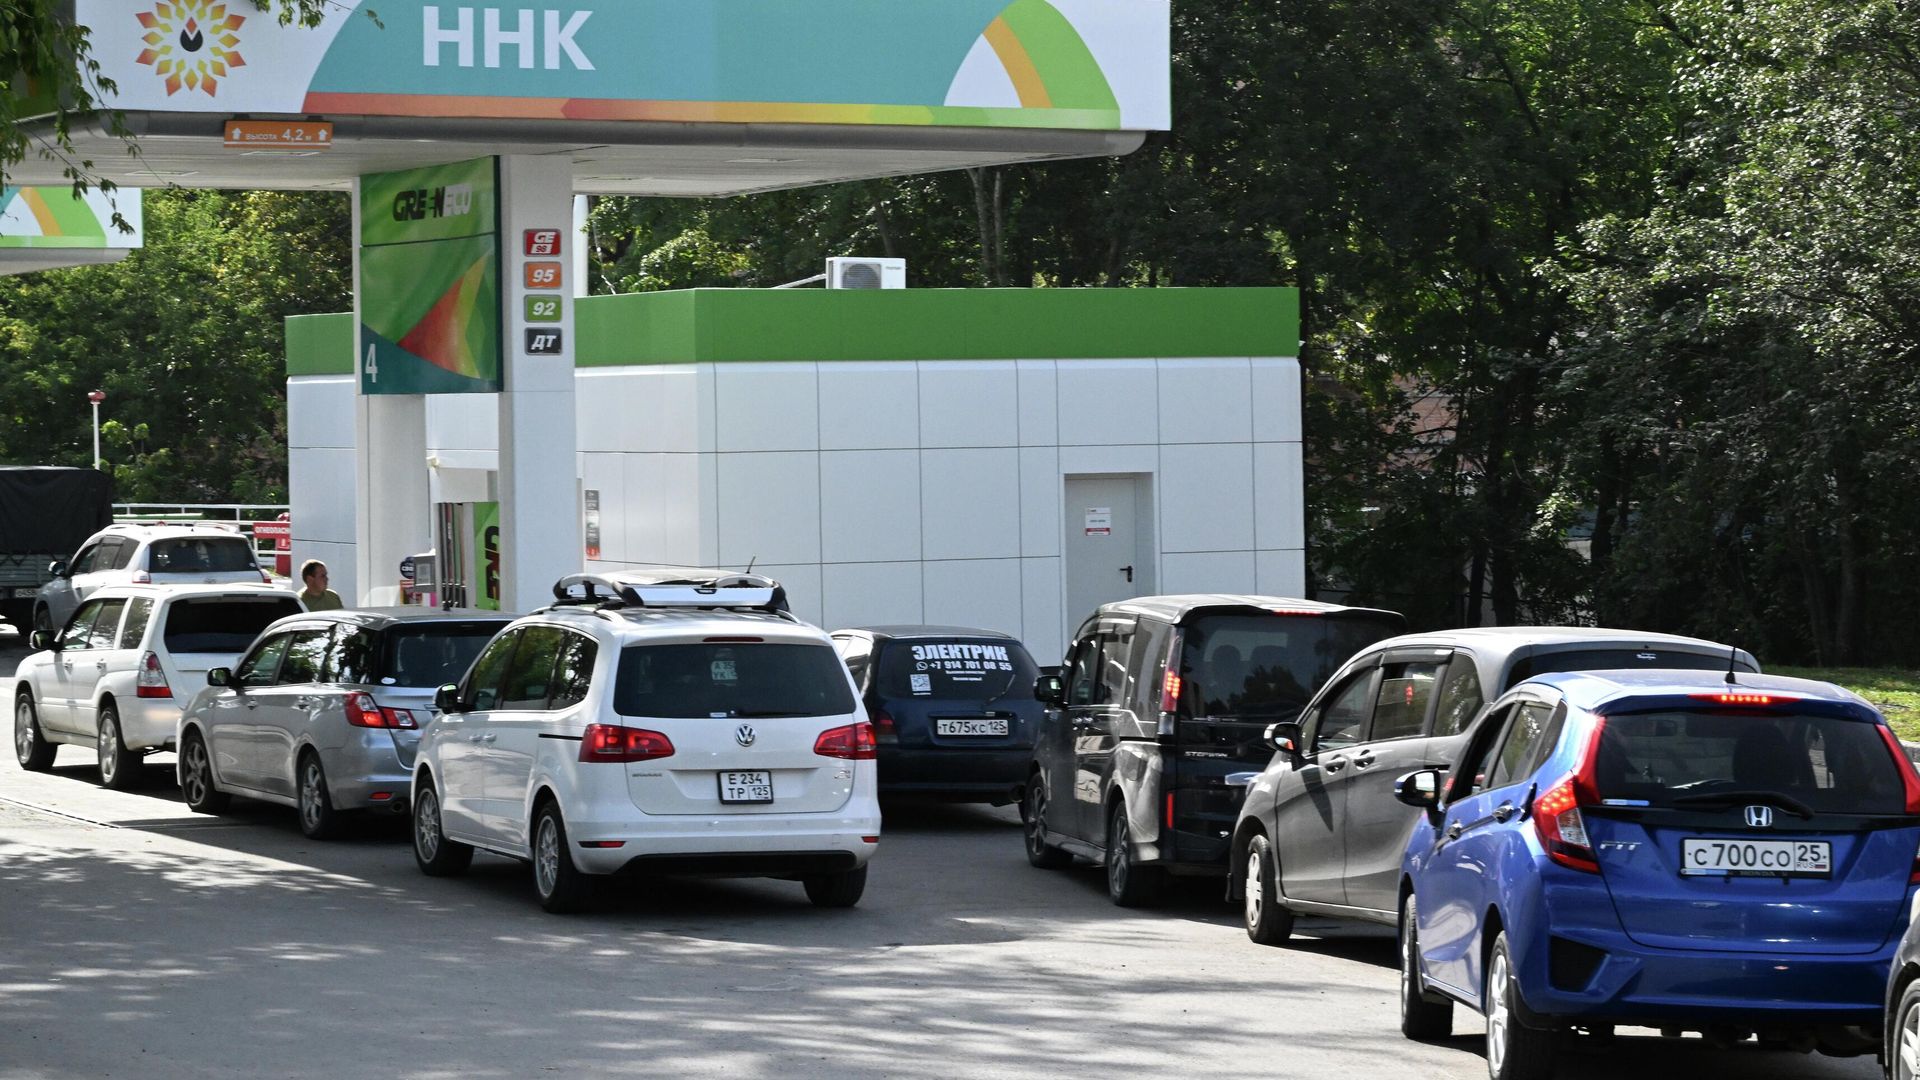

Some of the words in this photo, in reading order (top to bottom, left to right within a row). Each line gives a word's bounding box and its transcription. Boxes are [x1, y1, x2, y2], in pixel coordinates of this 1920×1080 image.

[423, 6, 596, 71] ННК
[282, 128, 304, 142] 4,2
[534, 231, 556, 243] GE
[532, 269, 555, 283] 95
[532, 301, 556, 315] 92
[531, 335, 557, 350] ДТ
[365, 343, 378, 383] 4
[911, 644, 1010, 661] ЭЛЕКТРИК
[929, 661, 942, 670] +7
[944, 661, 962, 670] 914
[964, 661, 982, 670] 701
[983, 661, 997, 671] 08
[999, 662, 1013, 672] 55
[728, 773, 737, 785] Е
[740, 773, 763, 785] 234
[728, 787, 746, 799] ТР
[752, 786, 769, 796] 125
[1694, 843, 1791, 868] С700СО
[1797, 844, 1822, 862] 25
